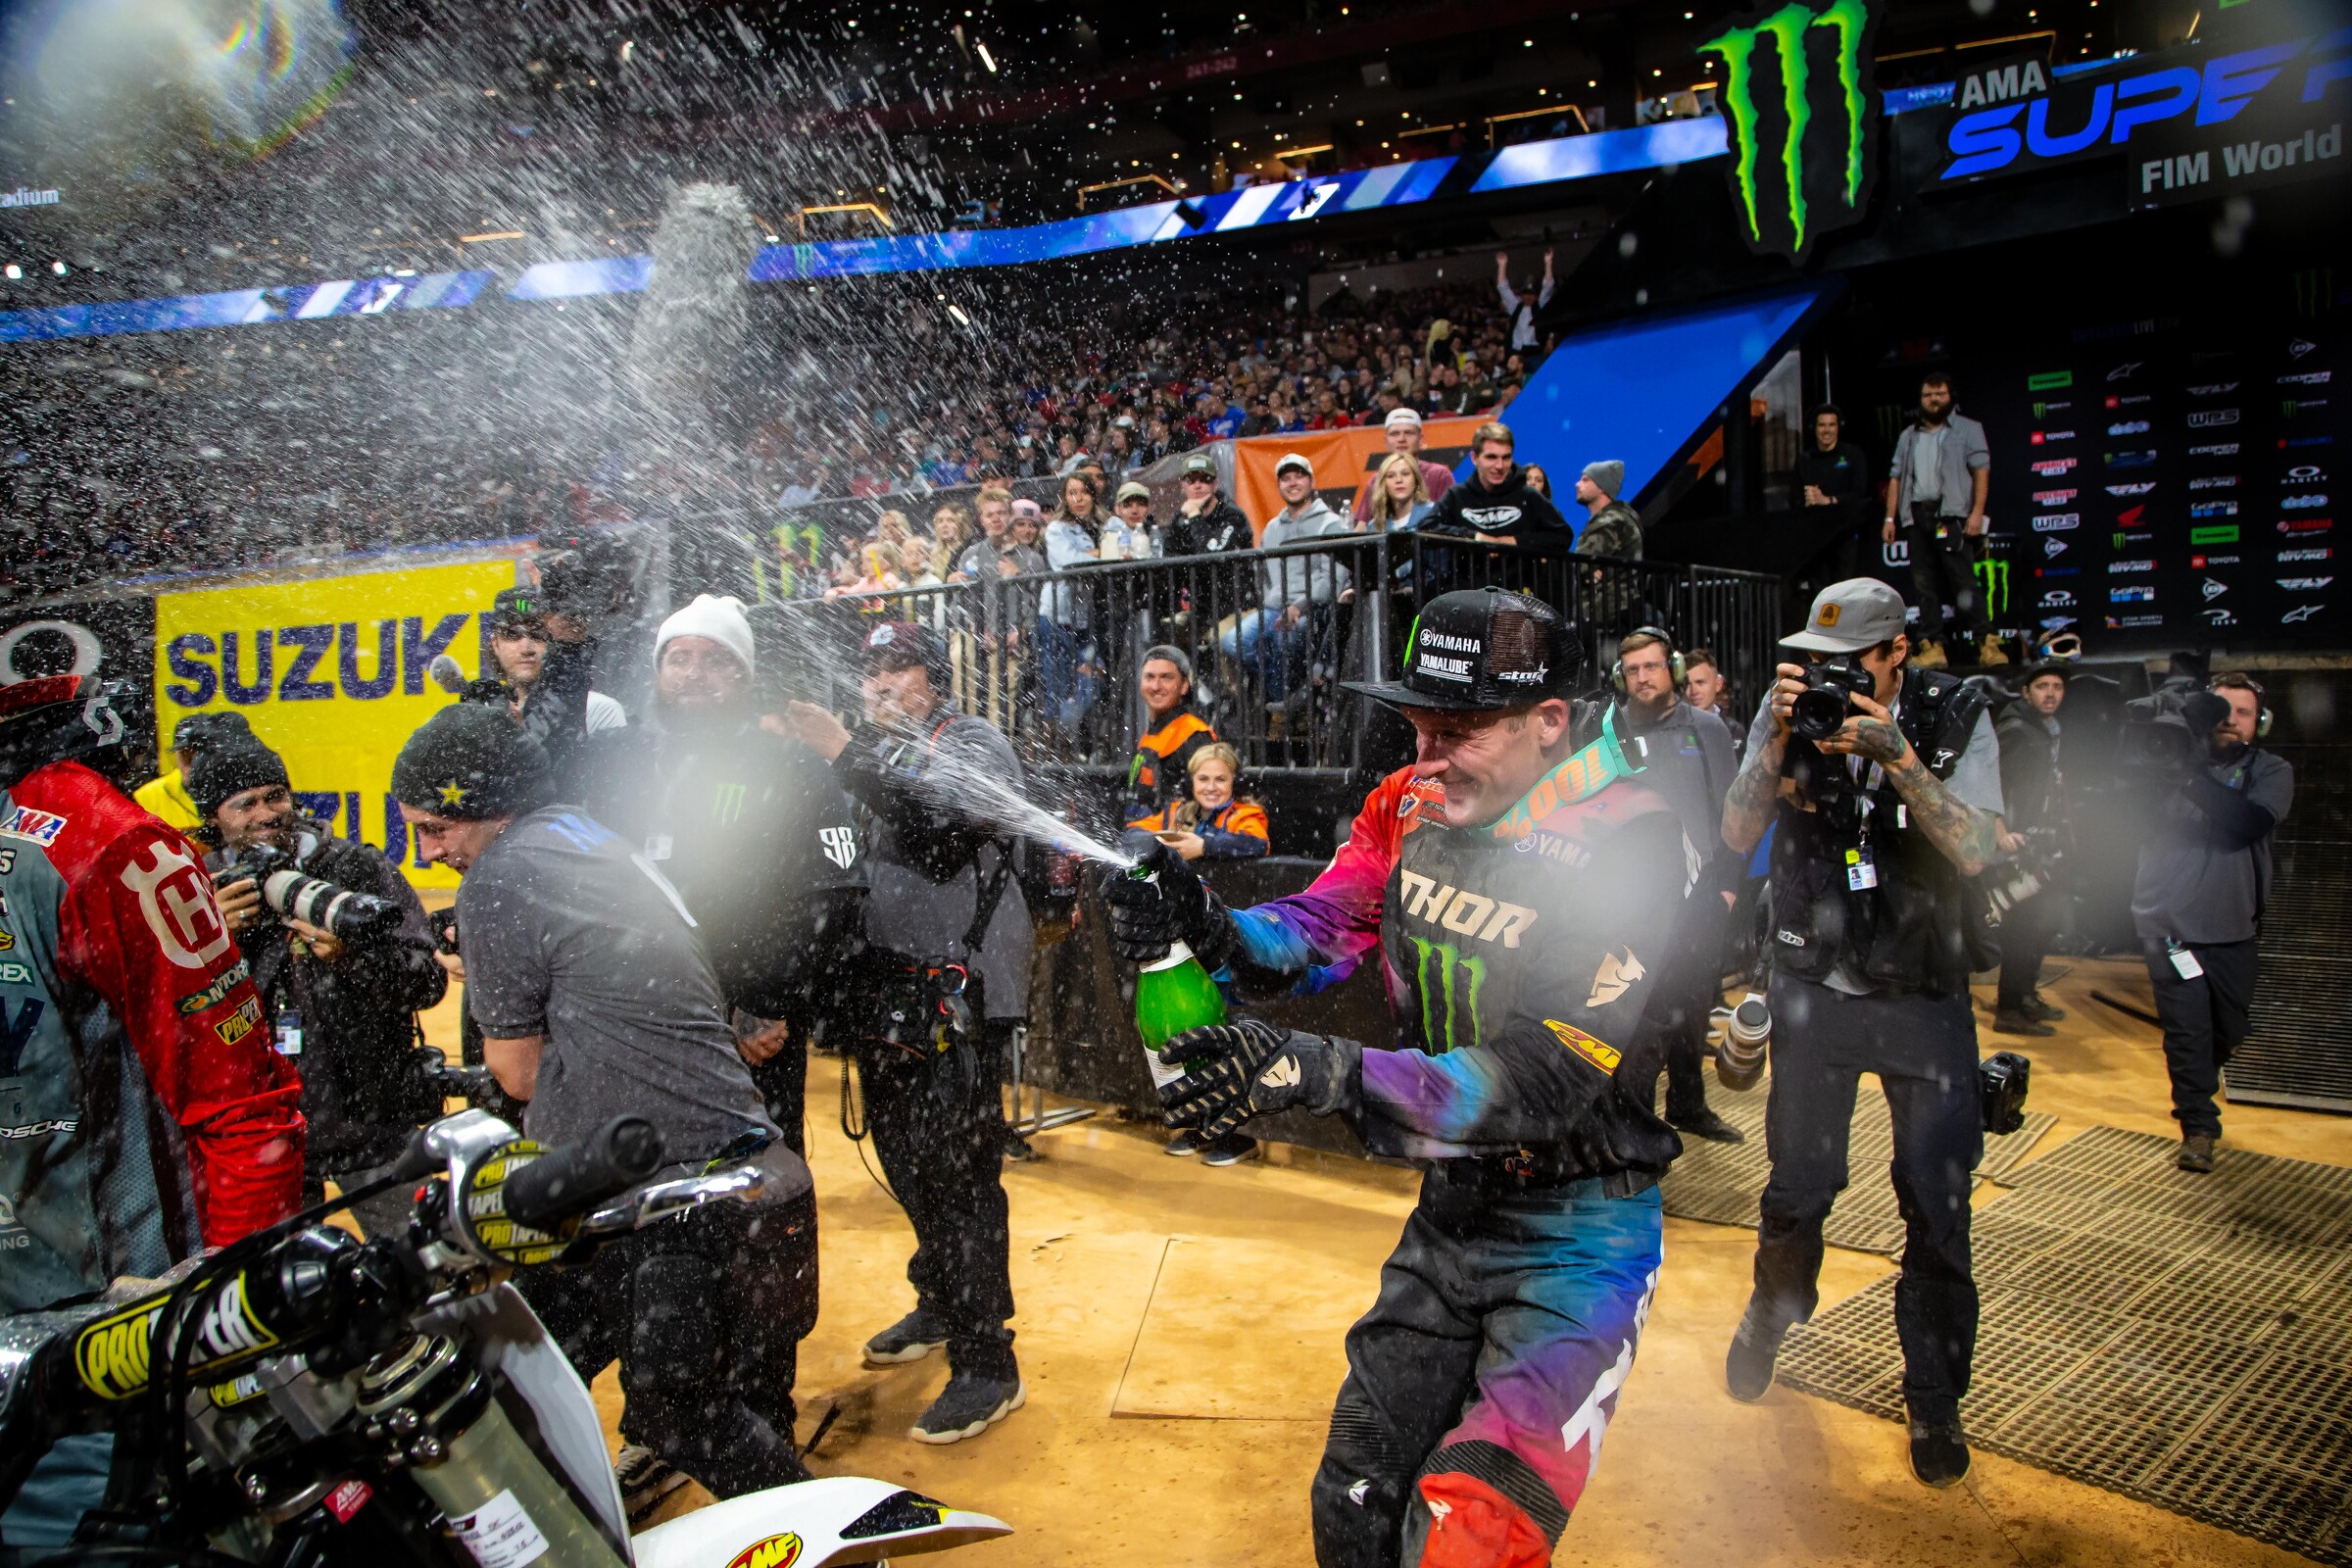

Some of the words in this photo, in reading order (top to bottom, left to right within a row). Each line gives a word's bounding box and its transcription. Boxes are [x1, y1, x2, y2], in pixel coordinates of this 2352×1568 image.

[1961, 60, 2047, 109] AMA
[2141, 151, 2209, 193] FIM
[2224, 123, 2341, 177] World
[0, 186, 59, 207] adium
[1433, 632, 1481, 654] YAMAHA
[1420, 653, 1469, 674] YAMALUBE
[818, 826, 857, 870] 98
[1538, 833, 1592, 869] YAMA
[1401, 868, 1538, 949] THOR
